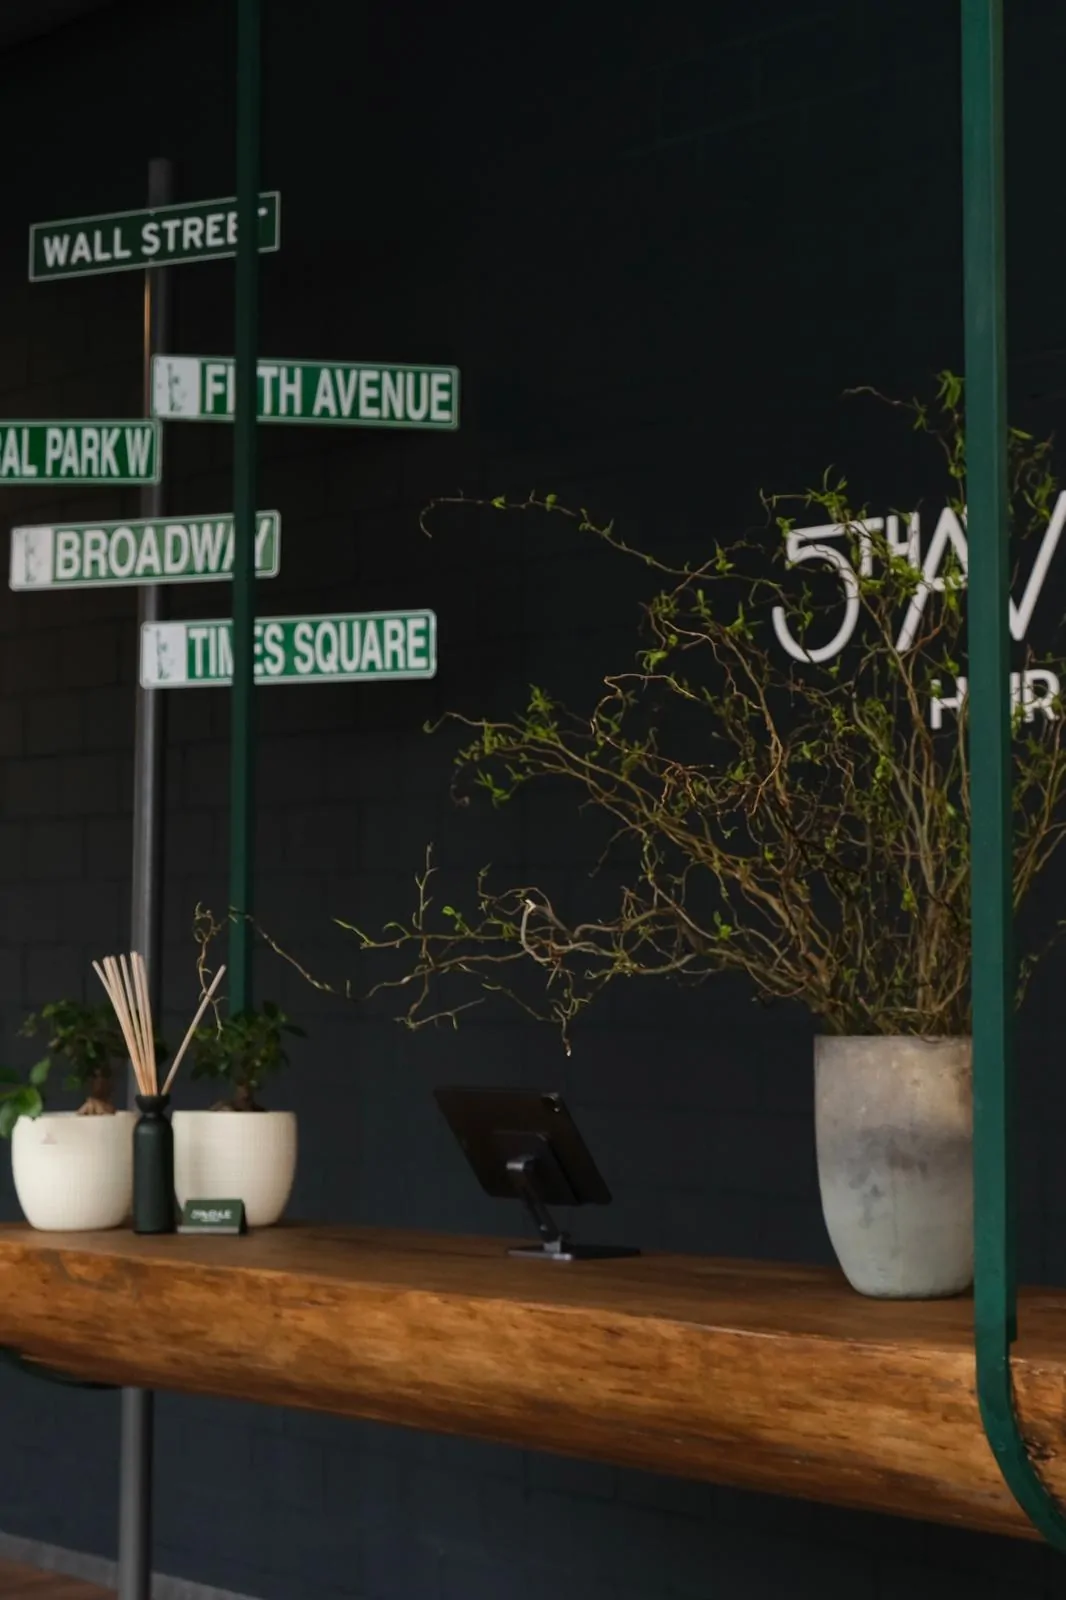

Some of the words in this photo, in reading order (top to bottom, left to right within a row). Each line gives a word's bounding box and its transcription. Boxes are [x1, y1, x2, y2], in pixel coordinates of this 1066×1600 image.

[43, 227, 132, 268] WALL
[141, 206, 268, 256] STREE
[205, 363, 301, 416] FITH
[312, 367, 451, 421] AVENUE
[0, 427, 38, 477] AL
[45, 427, 120, 477] PARK
[125, 427, 152, 477] W
[293, 617, 427, 674] SQUARE
[930, 669, 1061, 730] HIR
